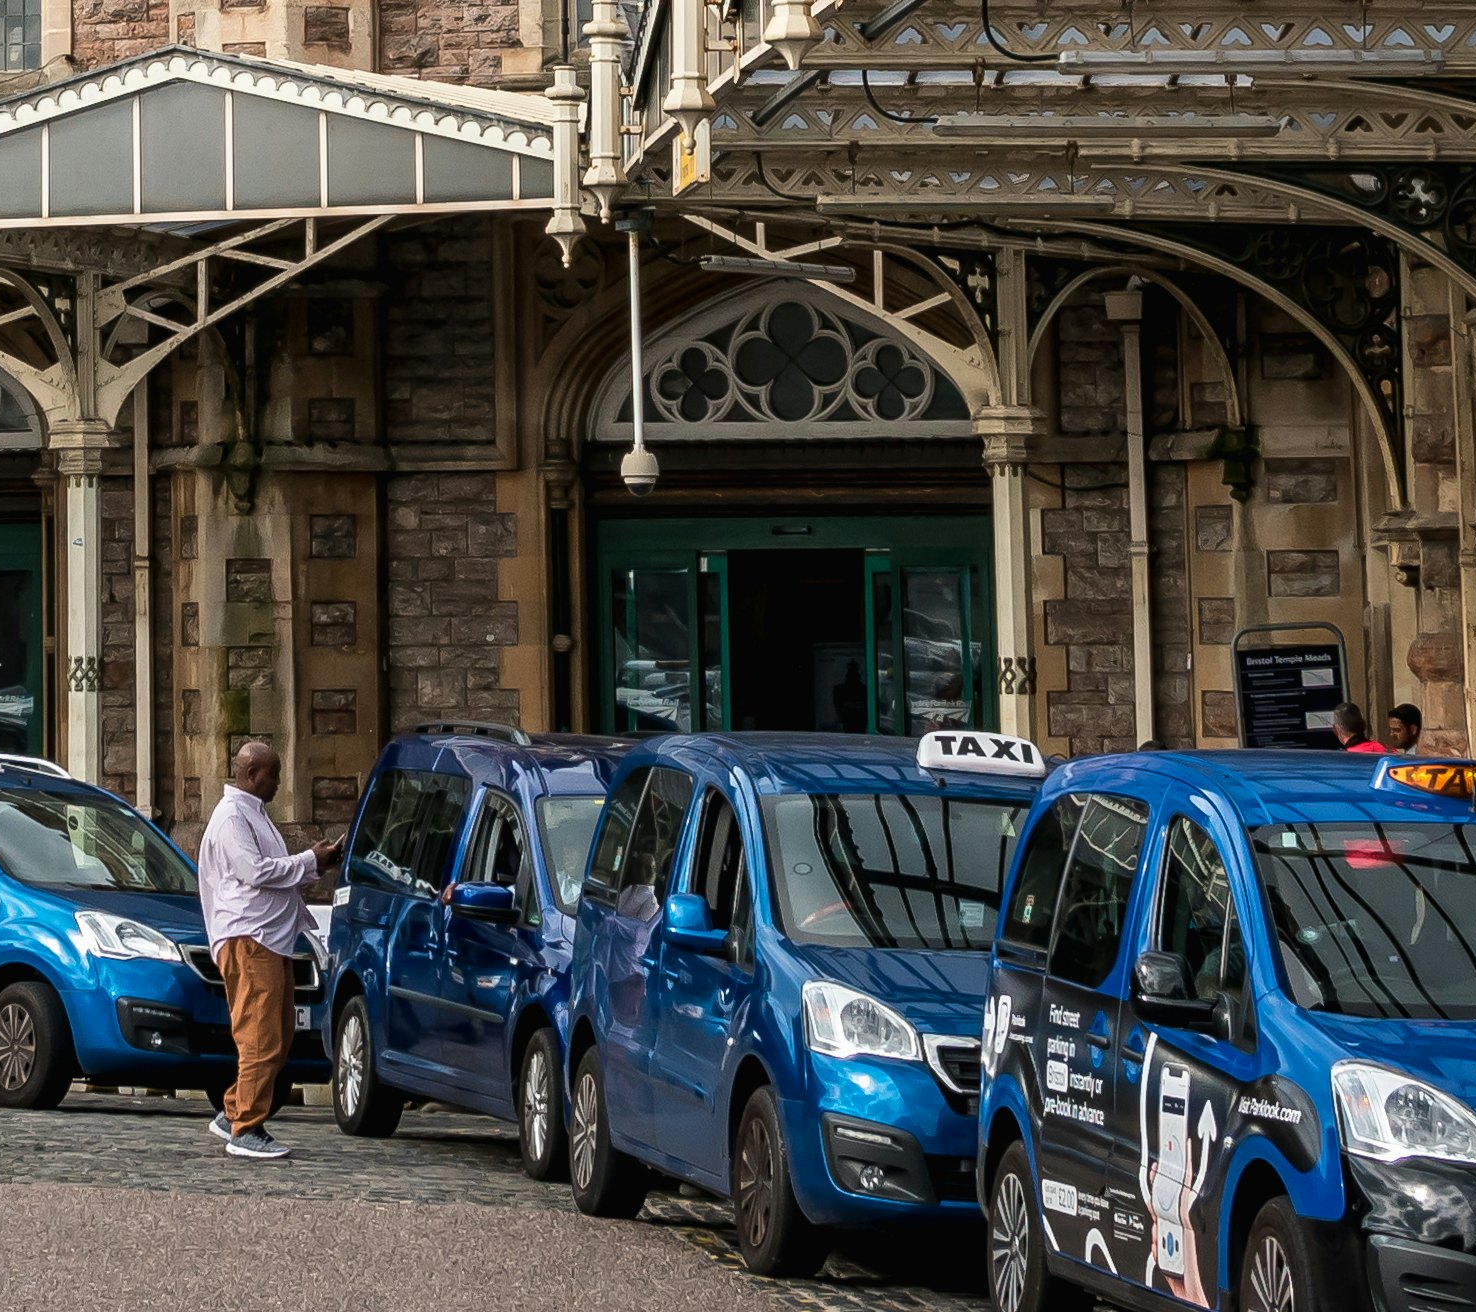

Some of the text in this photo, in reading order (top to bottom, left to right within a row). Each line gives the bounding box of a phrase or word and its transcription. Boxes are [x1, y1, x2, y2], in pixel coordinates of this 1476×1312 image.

[1246, 653, 1332, 666] Bristol Temple Meads
[934, 736, 1034, 764] TAXI
[1049, 1003, 1081, 1029] Find street
[1048, 1035, 1069, 1062] parking
[1069, 1038, 1076, 1058] in
[1070, 1068, 1097, 1098] instantly
[1096, 1079, 1104, 1095] or
[1043, 1095, 1072, 1117] pre-book
[1078, 1101, 1104, 1126] advance
[1250, 1098, 1302, 1124] Parklook.com
